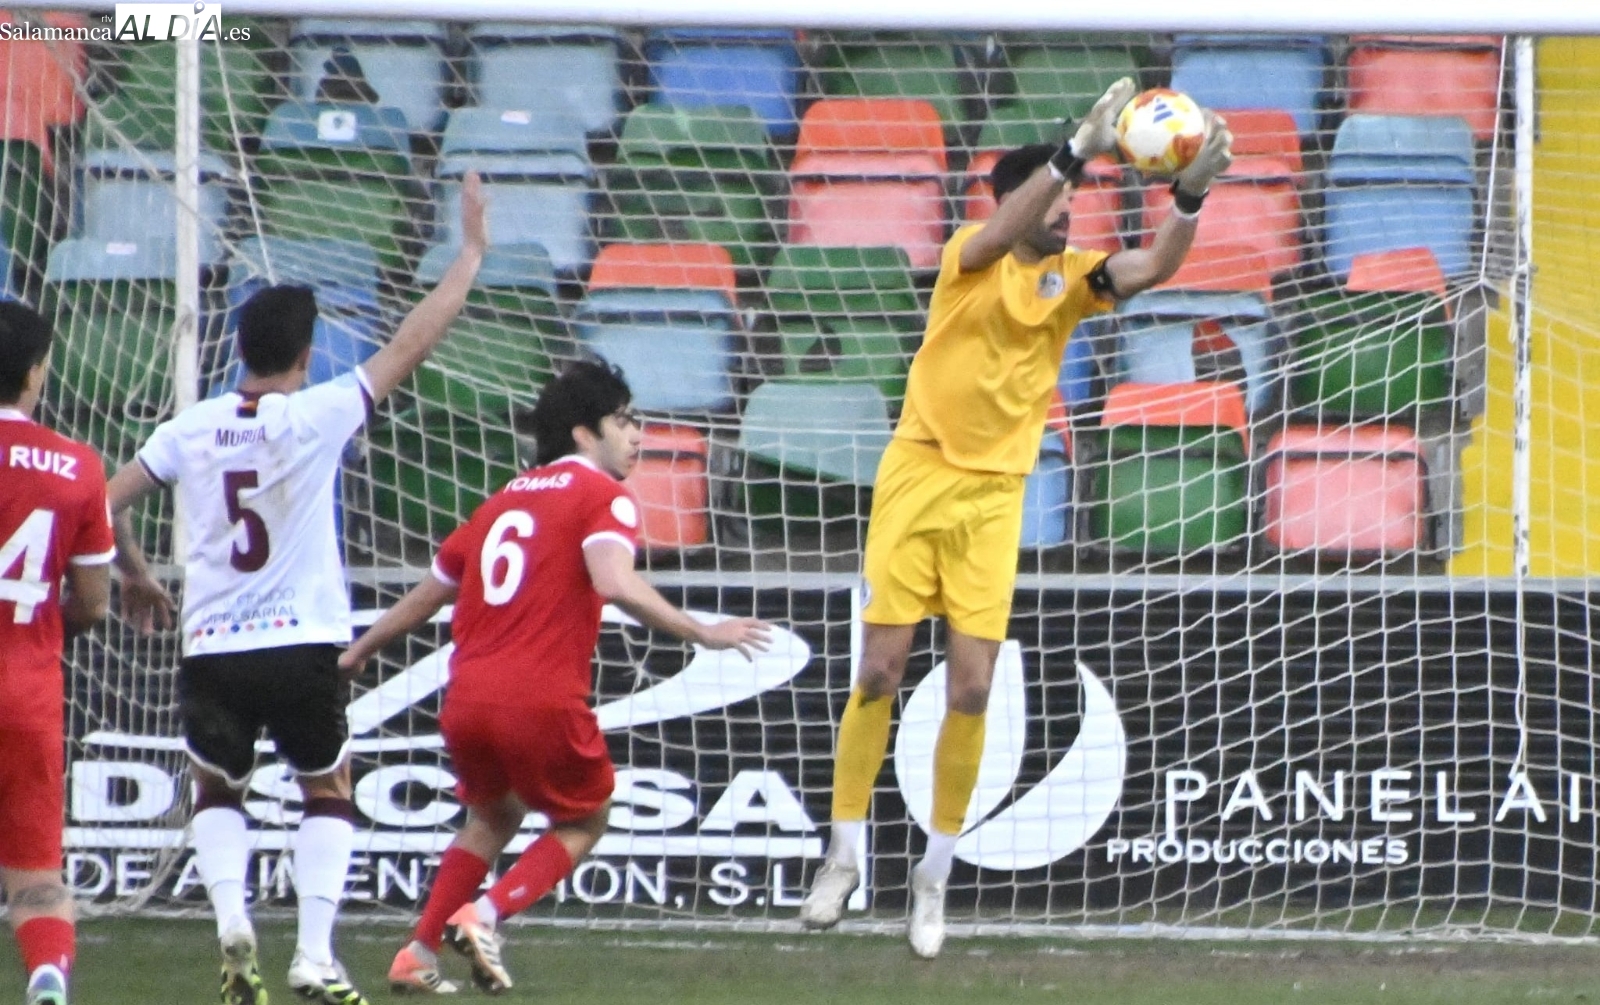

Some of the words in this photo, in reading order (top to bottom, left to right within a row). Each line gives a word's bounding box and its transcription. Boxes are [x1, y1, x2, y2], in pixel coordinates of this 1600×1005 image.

[9, 446, 77, 480] RUIZ
[223, 470, 269, 573] 5
[0, 509, 54, 624] 4
[481, 510, 534, 606] 6
[72, 761, 816, 831] DSCSA
[67, 853, 151, 896] DE
[1106, 838, 1409, 864] PRODUCCIONES
